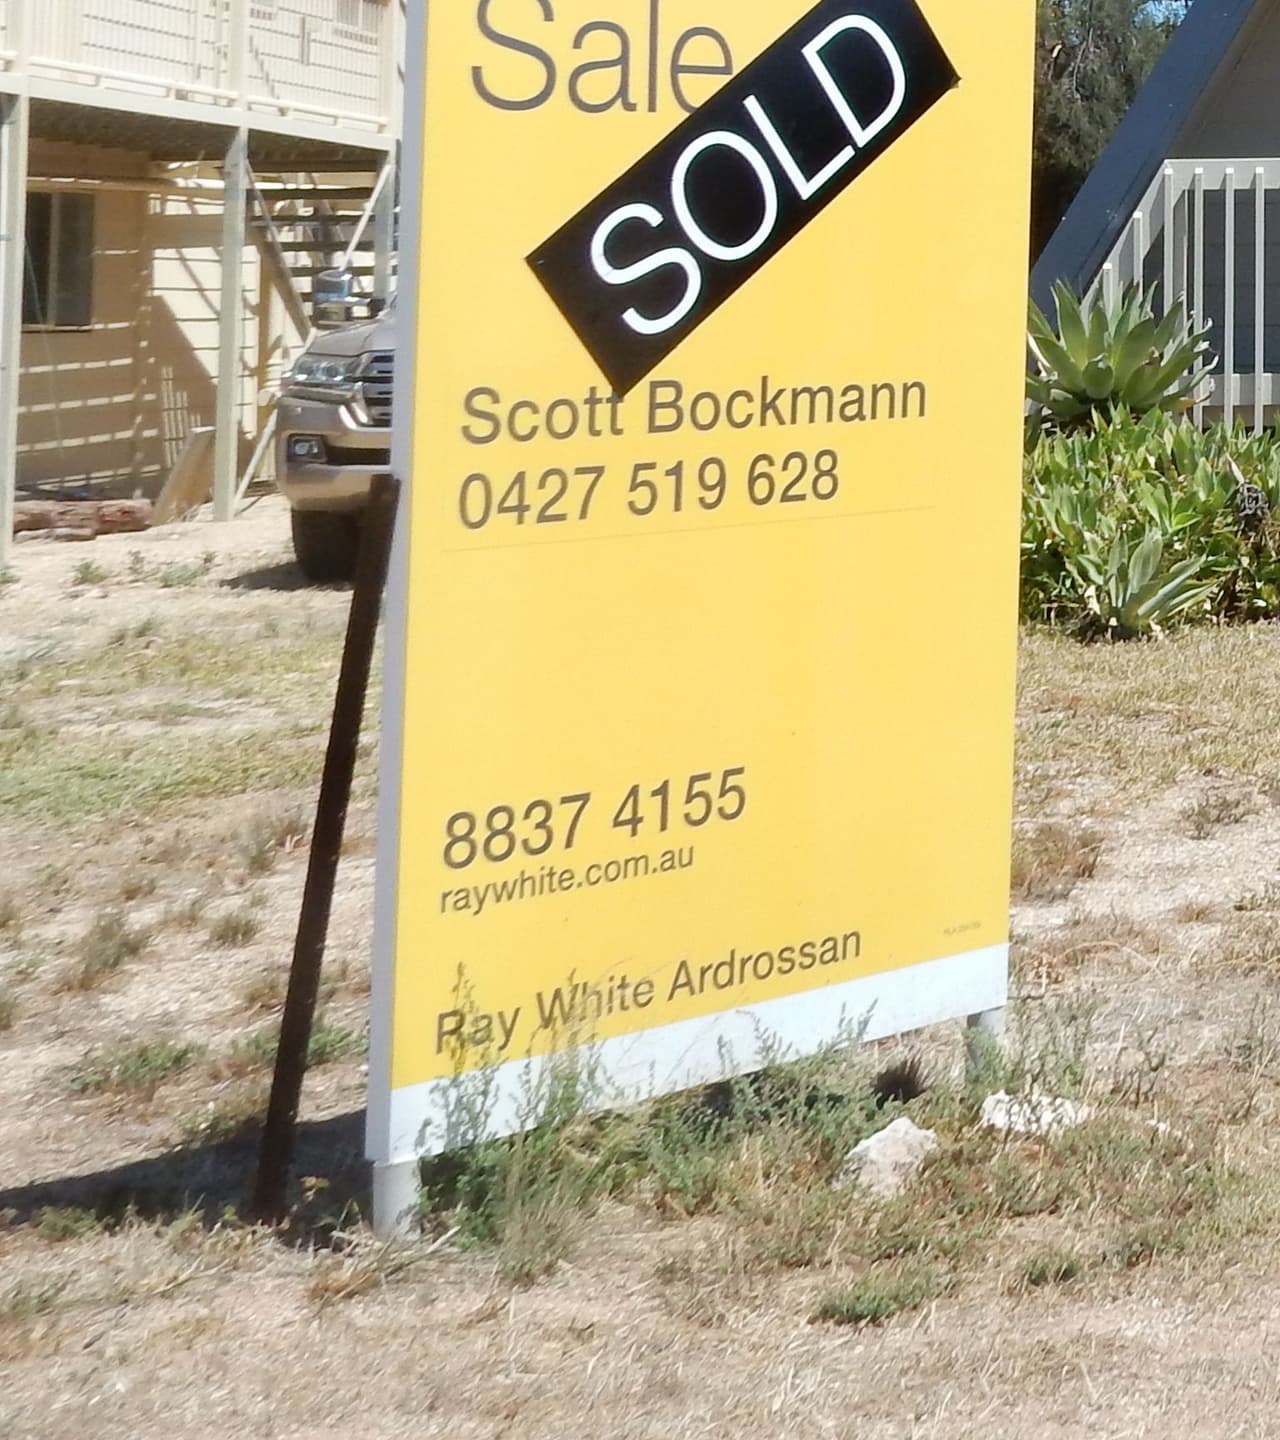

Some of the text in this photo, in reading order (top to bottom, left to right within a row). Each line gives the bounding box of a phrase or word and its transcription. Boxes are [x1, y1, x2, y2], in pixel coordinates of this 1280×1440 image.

[590, 13, 907, 335] SOLD
[461, 375, 927, 444] Scott Bockmann
[458, 449, 839, 529] 0427 519 628
[443, 766, 746, 870] 8837 4155
[440, 845, 694, 915] raywhite.com.au
[436, 929, 861, 1054] Ray White Ardrossan
